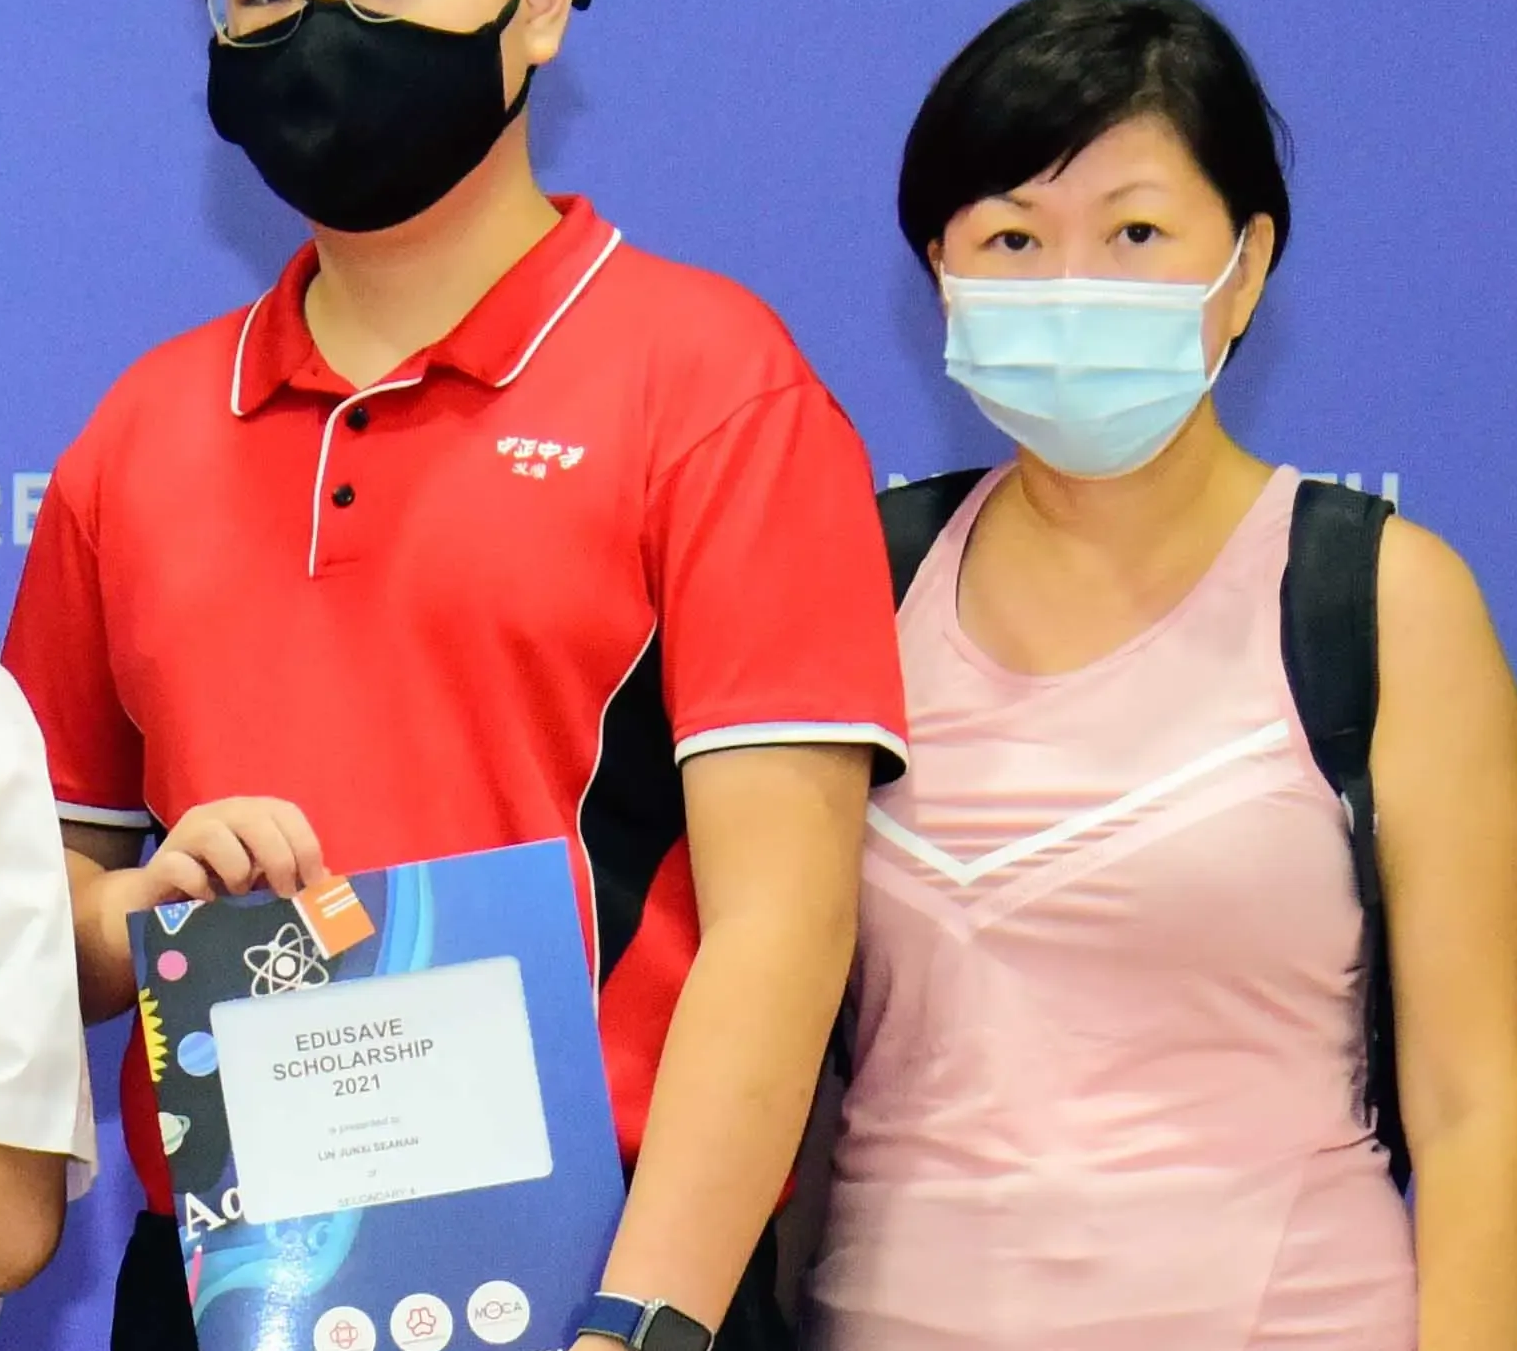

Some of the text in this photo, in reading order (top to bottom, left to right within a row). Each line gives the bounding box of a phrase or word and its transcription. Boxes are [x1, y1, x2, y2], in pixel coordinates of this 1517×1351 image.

[295, 1017, 404, 1052] EDUSAVE
[272, 1037, 435, 1082] SCHOLARSHIP
[332, 1073, 382, 1097] 2021
